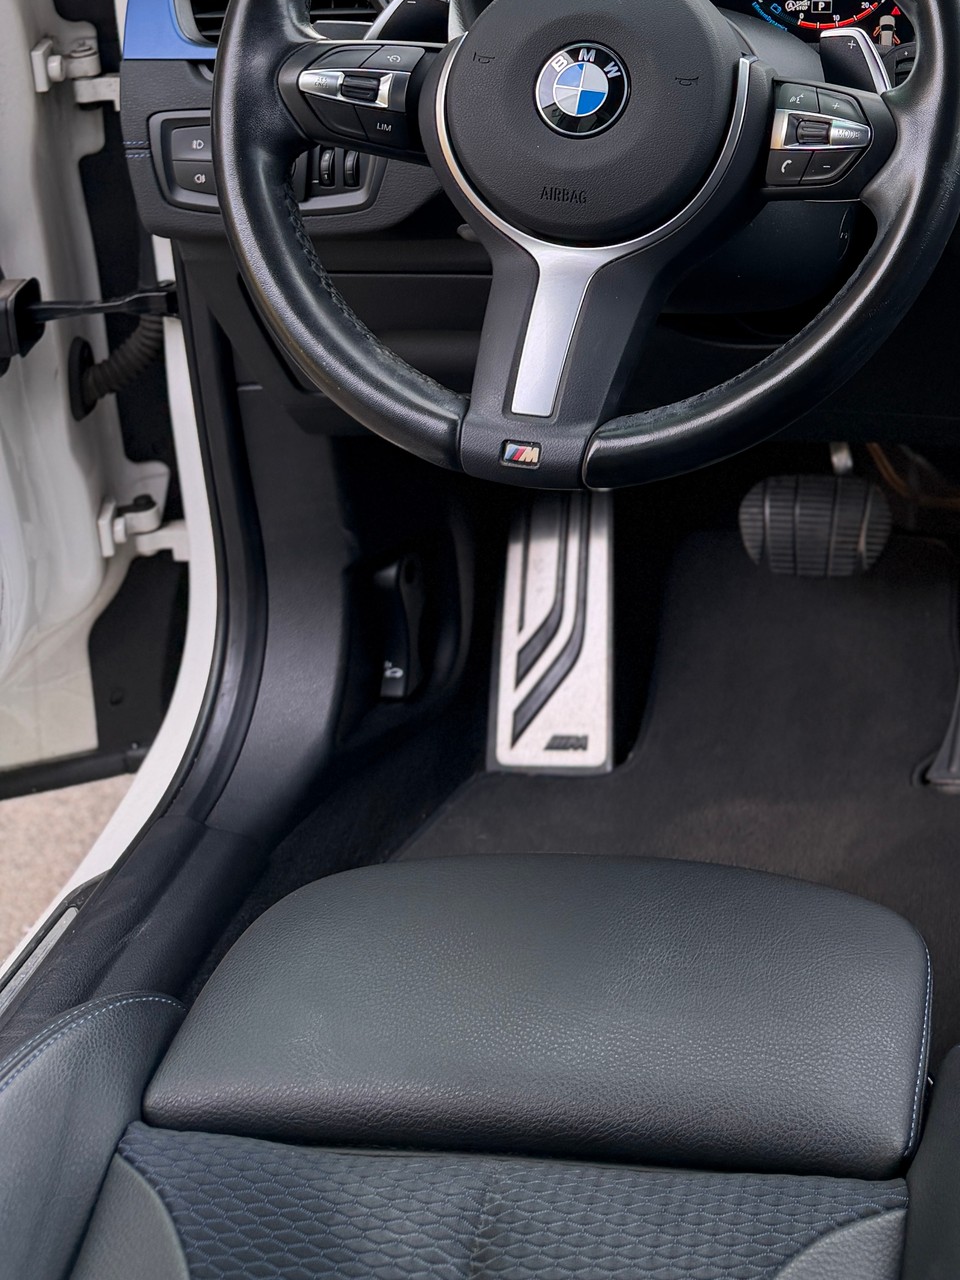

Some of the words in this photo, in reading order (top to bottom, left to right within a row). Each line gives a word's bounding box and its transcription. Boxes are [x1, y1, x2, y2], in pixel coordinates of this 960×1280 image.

[818, 1, 825, 11] P
[550, 48, 622, 79] BMW
[376, 122, 392, 132] LIM
[540, 185, 587, 205] AIRBAG
